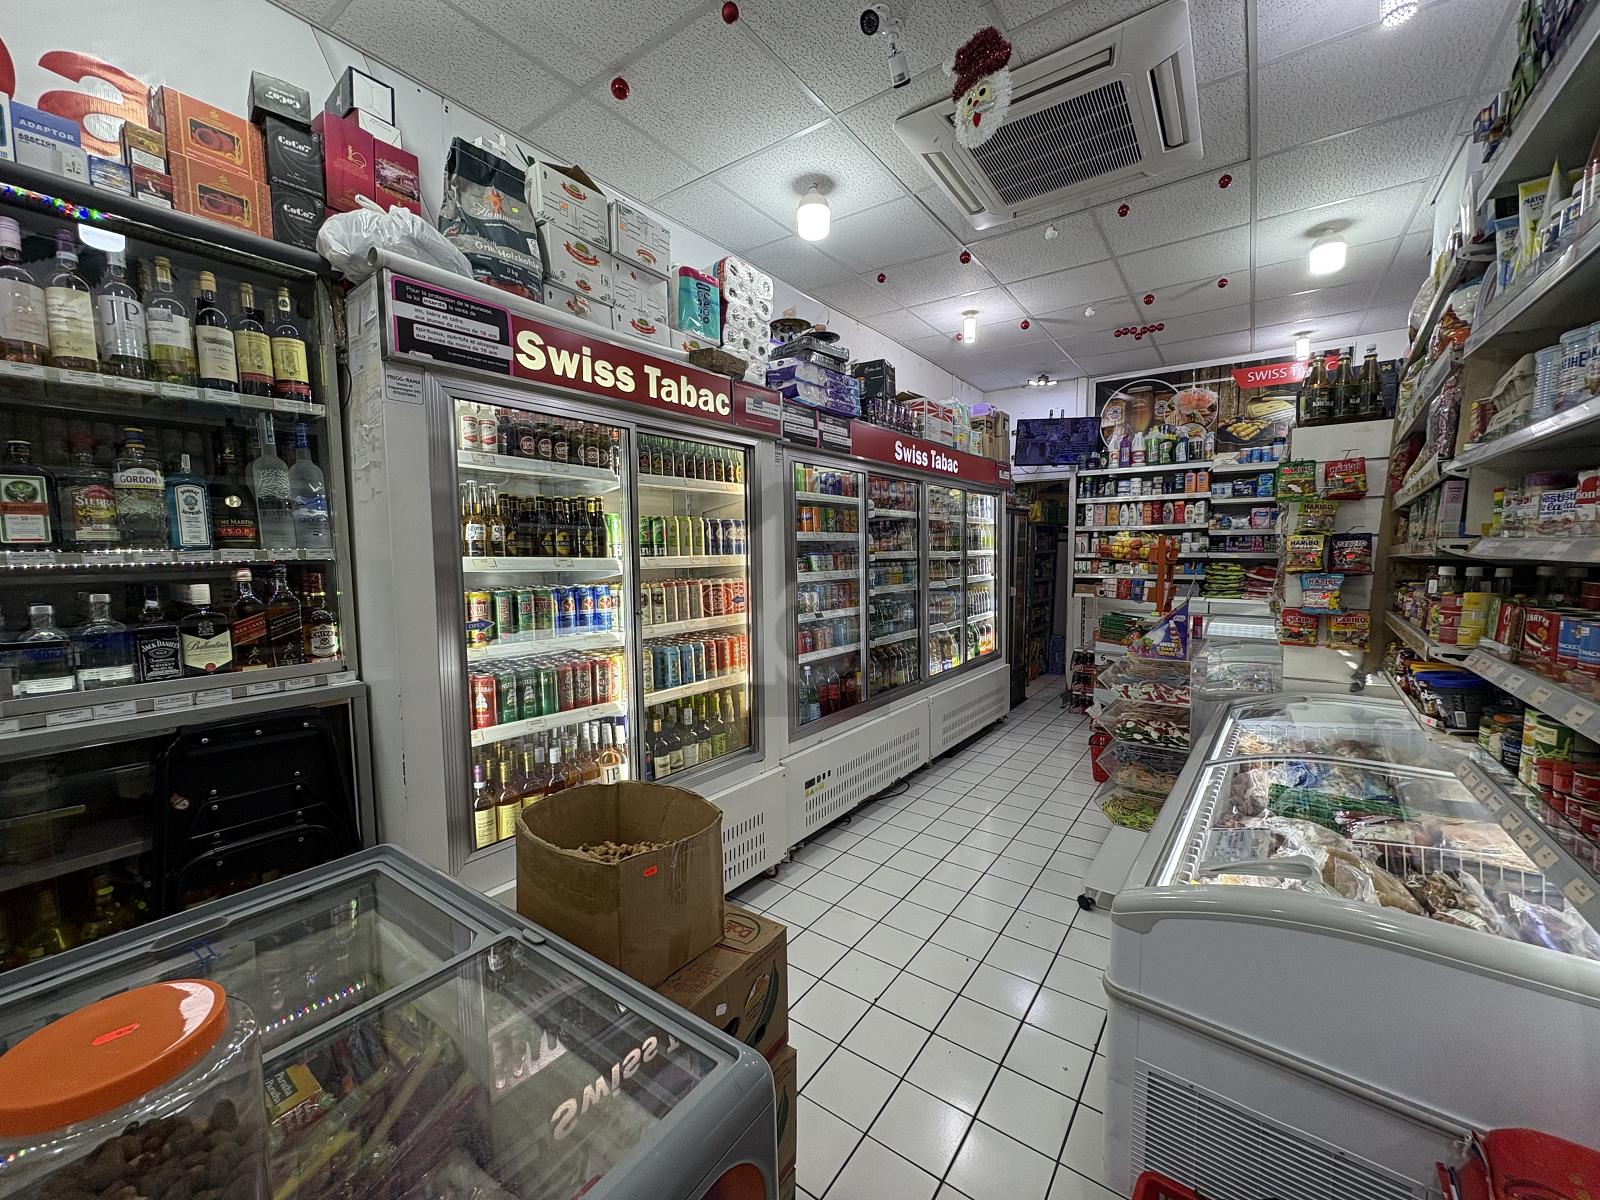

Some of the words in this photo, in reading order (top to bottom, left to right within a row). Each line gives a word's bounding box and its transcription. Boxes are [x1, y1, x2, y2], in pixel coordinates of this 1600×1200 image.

[19, 118, 75, 142] ADAPTOR
[277, 135, 312, 153] CoCo7
[283, 203, 316, 220] CoCo7
[406, 285, 420, 294] Pour
[428, 292, 456, 304] protection
[106, 299, 140, 326] JP
[415, 333, 427, 341] aux
[516, 330, 636, 393] Swiss
[644, 364, 731, 416] Tabac
[1247, 366, 1288, 383] SWISS
[894, 440, 928, 467] Swiss
[930, 450, 959, 473] Tabac
[1329, 463, 1361, 473] HARIBO
[76, 495, 115, 507] SIERRA
[1290, 539, 1320, 547] HARIBO
[1308, 578, 1340, 586] HARIBO
[140, 643, 157, 652] JACK
[606, 766, 620, 781] JP
